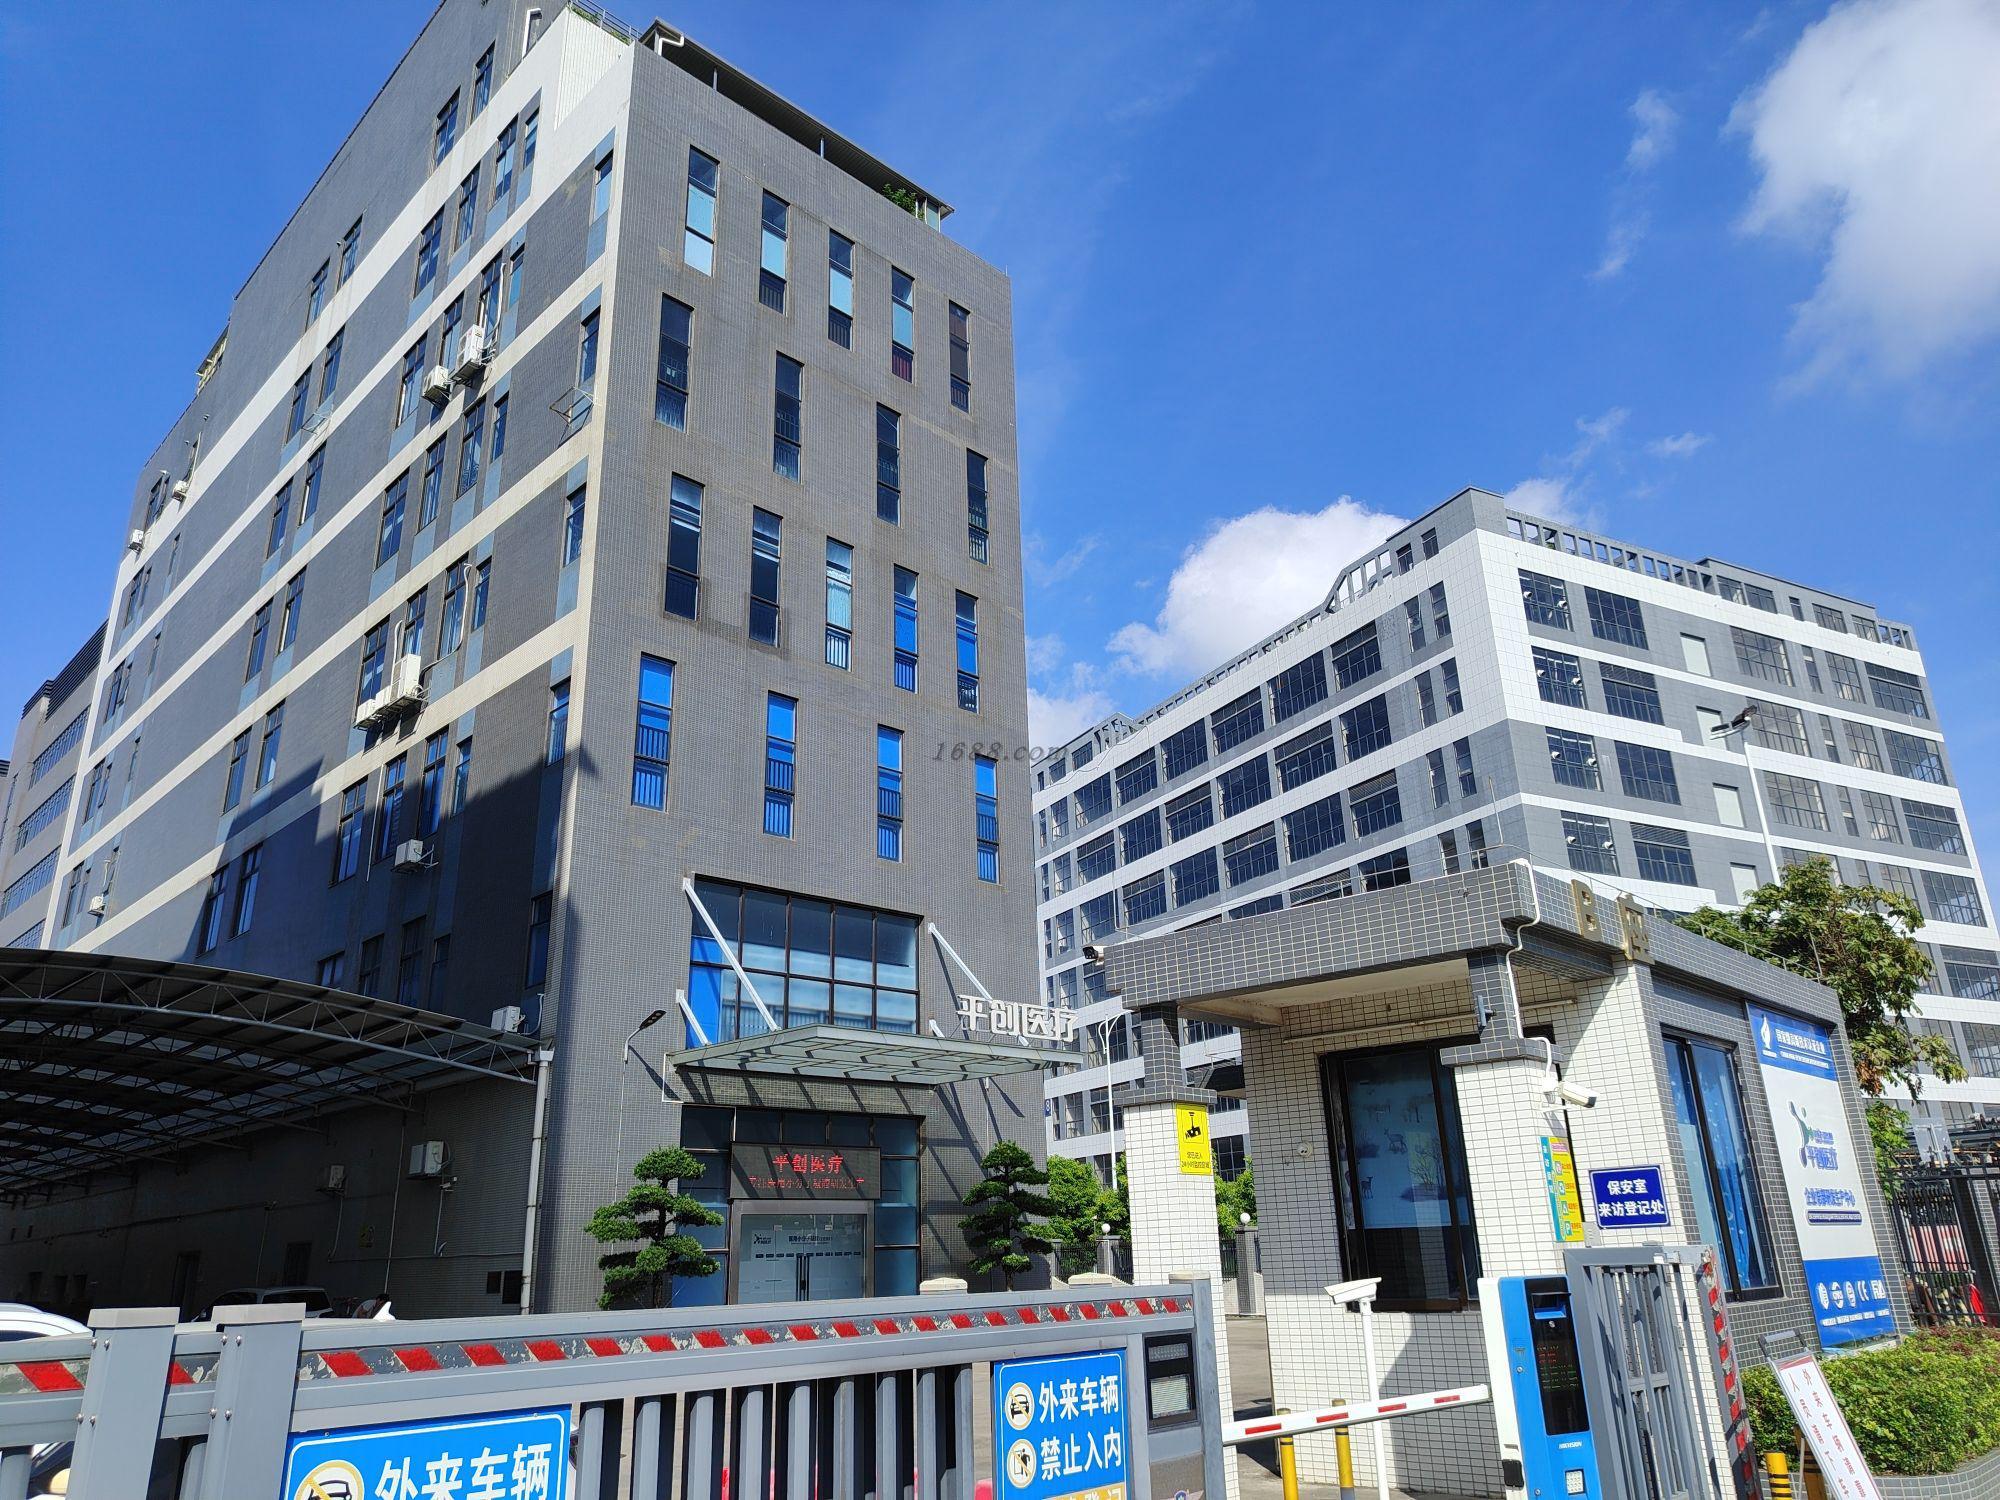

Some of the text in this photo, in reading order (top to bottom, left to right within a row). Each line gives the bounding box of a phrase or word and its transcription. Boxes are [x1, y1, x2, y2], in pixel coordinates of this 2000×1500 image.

[956, 995, 1078, 1042] 平创医疗
[772, 1153, 843, 1174] 平创医疗
[1598, 1199, 1665, 1218] 来访登记处
[1607, 1179, 1649, 1196] 保安室
[1038, 1374, 1119, 1424] 外来车辆
[374, 1442, 553, 1500] 外来车辆
[1040, 1426, 1122, 1481] 禁止入内
